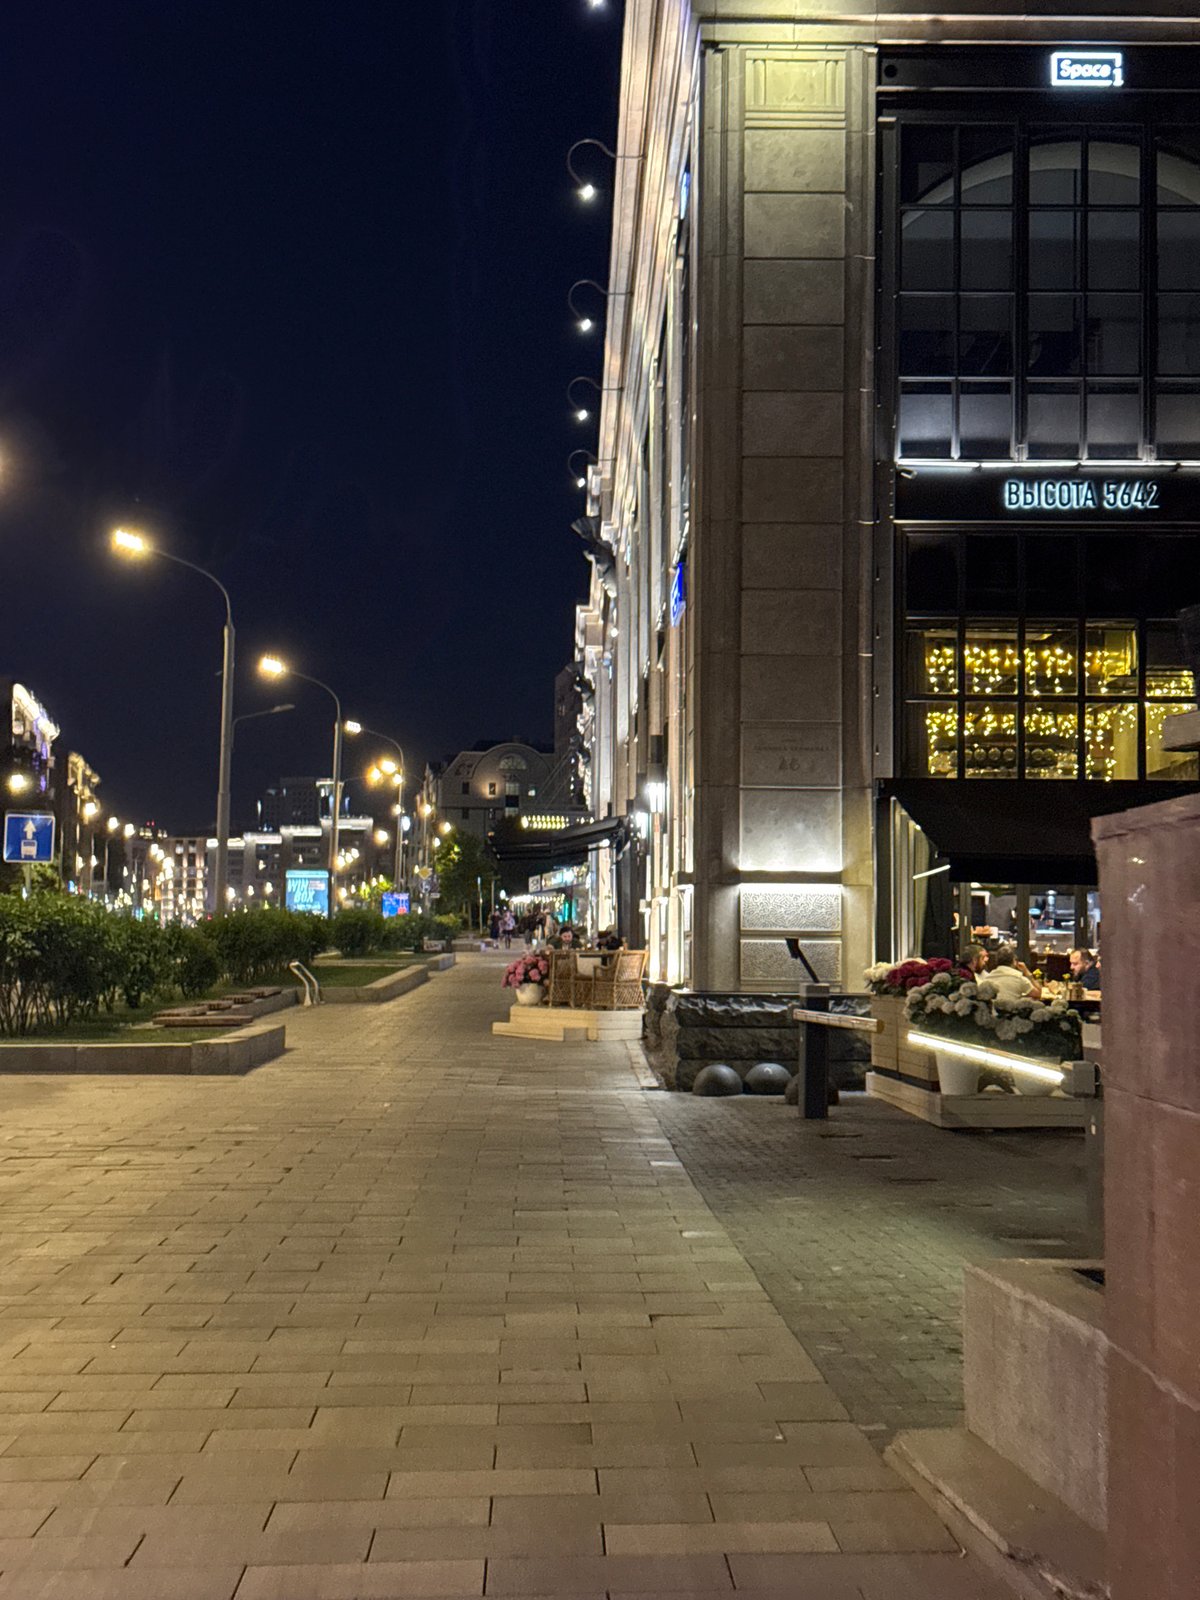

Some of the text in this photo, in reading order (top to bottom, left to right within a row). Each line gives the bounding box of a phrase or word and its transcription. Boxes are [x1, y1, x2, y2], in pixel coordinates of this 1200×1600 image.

[1060, 59, 1111, 80] Space
[1005, 480, 1160, 508] ВЫСОТА 5642
[293, 889, 315, 904] BOX
